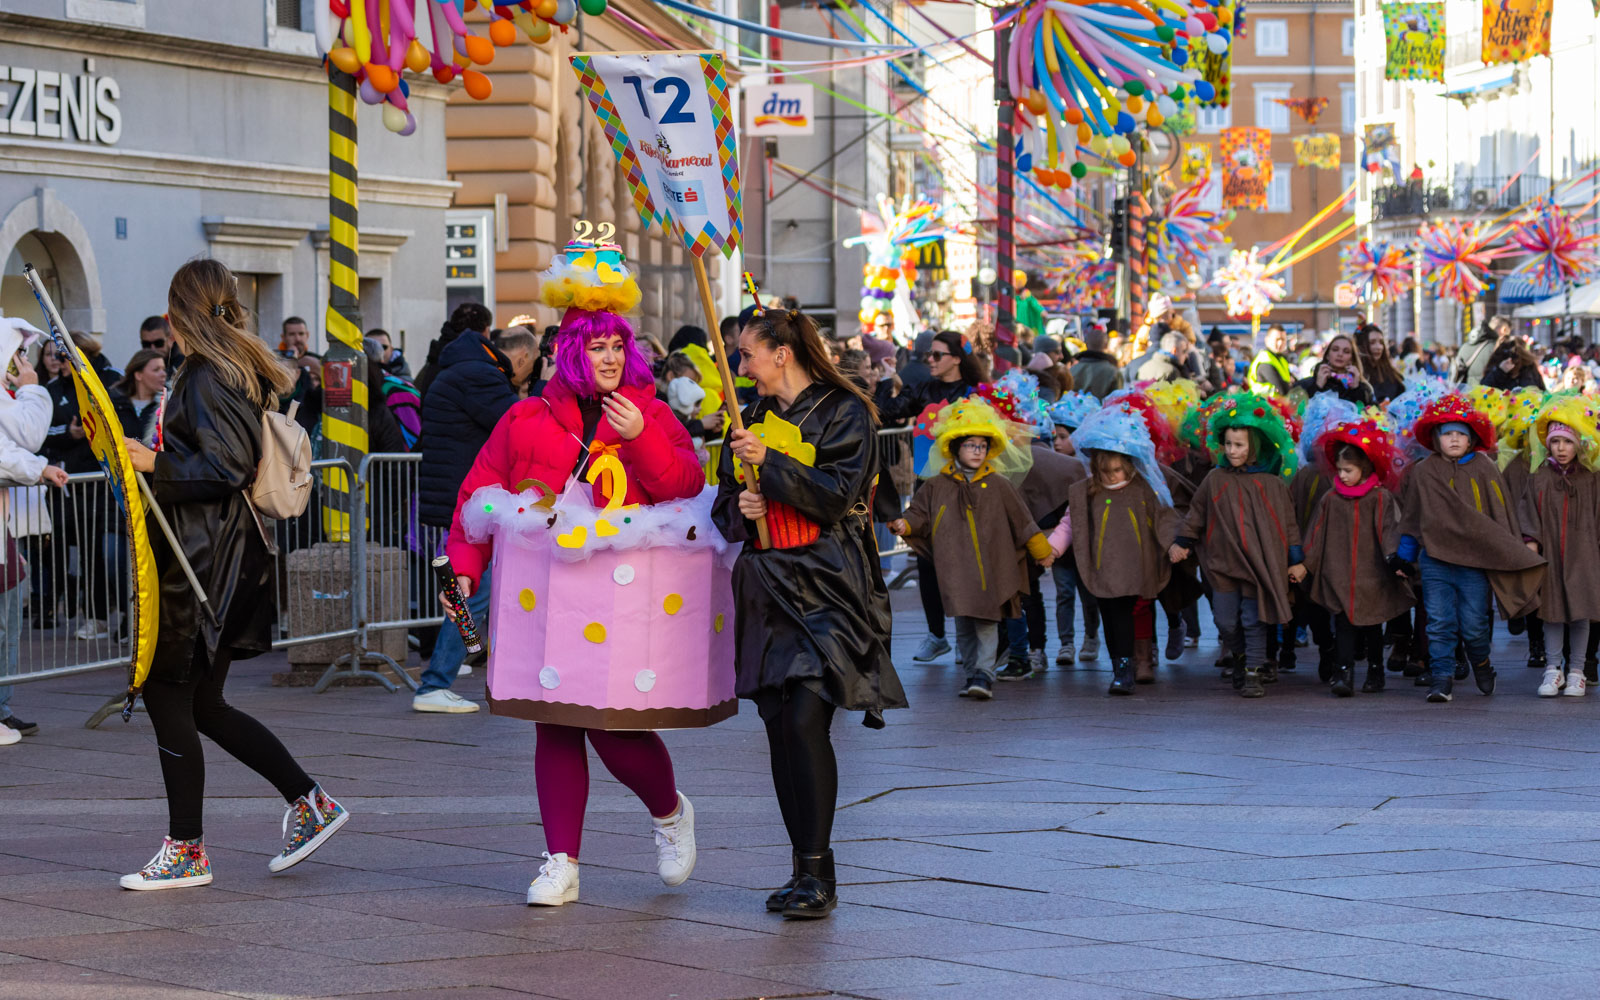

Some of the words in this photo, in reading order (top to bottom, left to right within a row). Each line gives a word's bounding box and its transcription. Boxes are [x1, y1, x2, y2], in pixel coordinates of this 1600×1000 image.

[623, 75, 696, 124] 12
[763, 92, 801, 114] dm
[574, 219, 616, 246] 22
